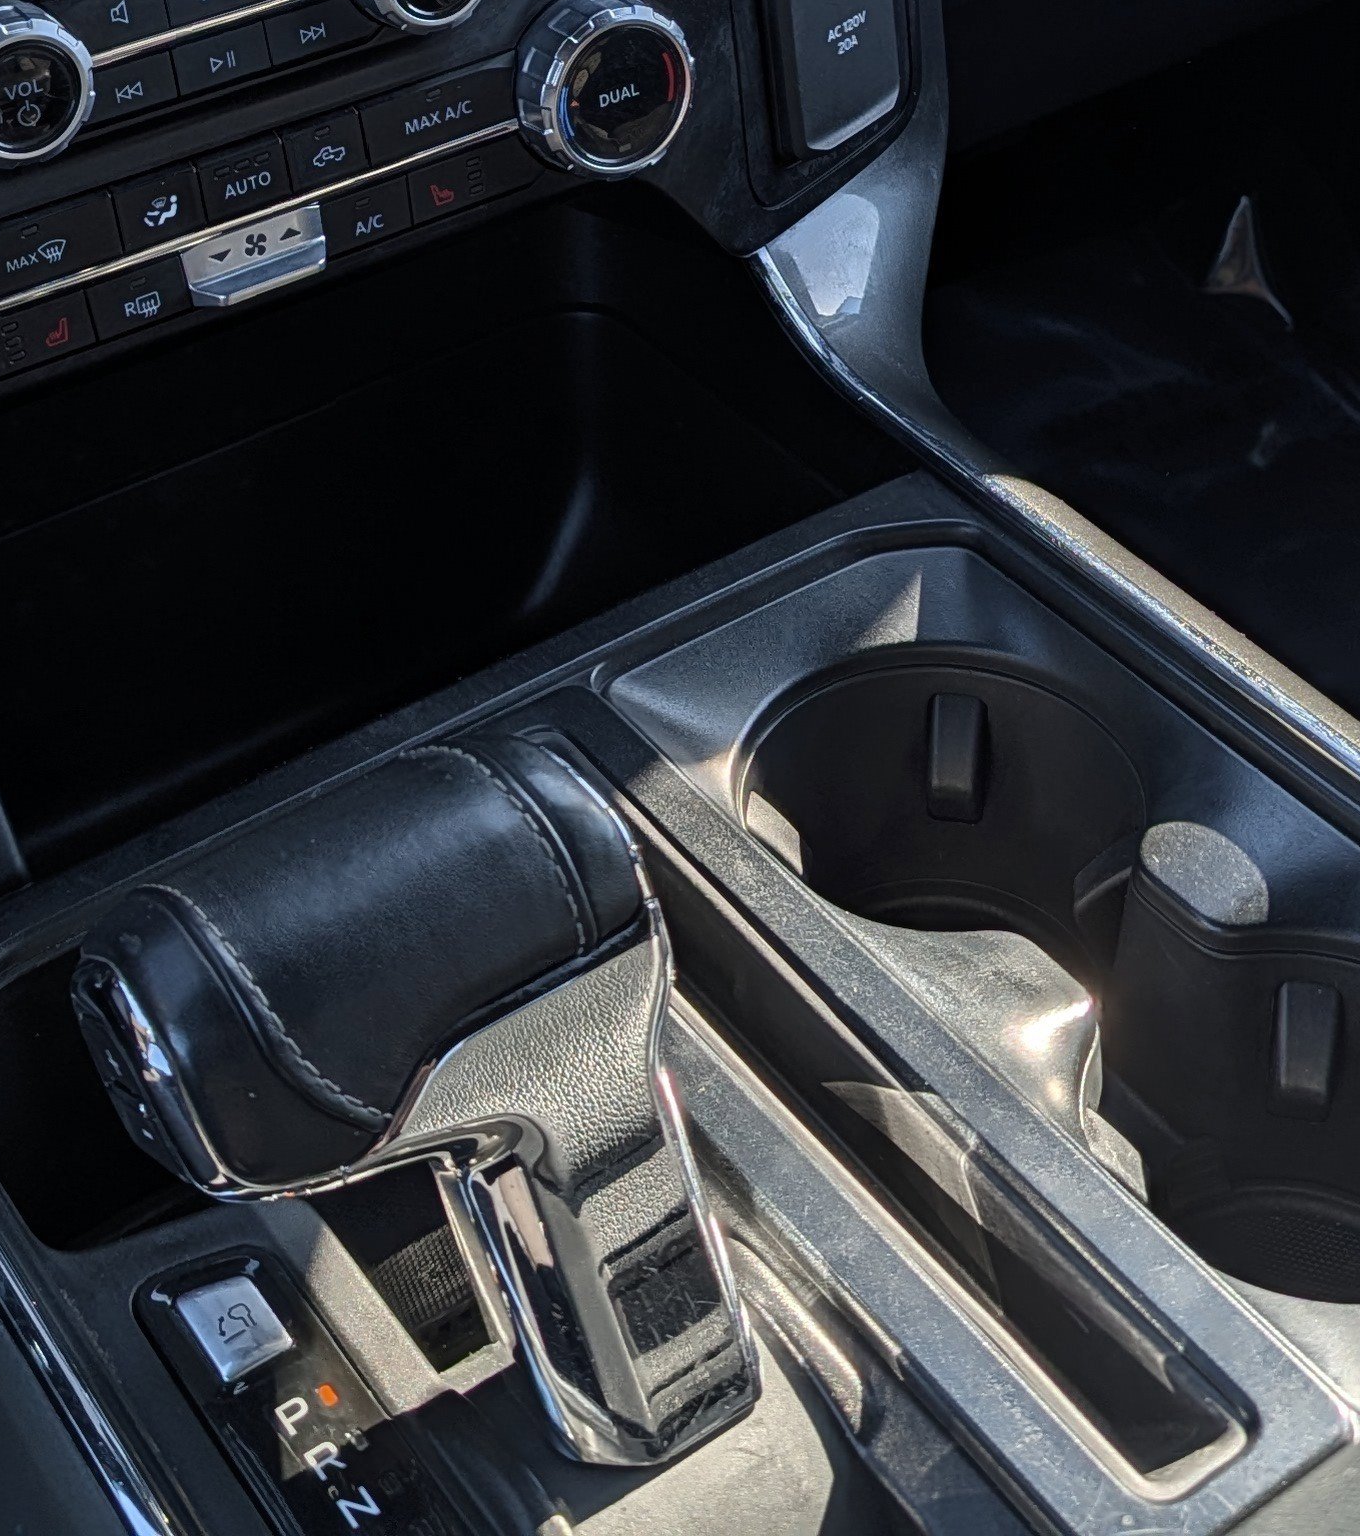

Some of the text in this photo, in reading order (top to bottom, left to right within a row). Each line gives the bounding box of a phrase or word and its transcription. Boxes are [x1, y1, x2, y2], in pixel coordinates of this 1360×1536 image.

[827, 25, 842, 42] AC
[4, 80, 43, 102] VOL
[598, 83, 640, 108] DUAL
[404, 99, 474, 135] MAX A/C
[224, 170, 272, 200] AUTO
[354, 214, 385, 238] A/C
[6, 252, 40, 273] MAX
[274, 1396, 309, 1437] P
[303, 1441, 347, 1482] R
[336, 1485, 381, 1530] N
